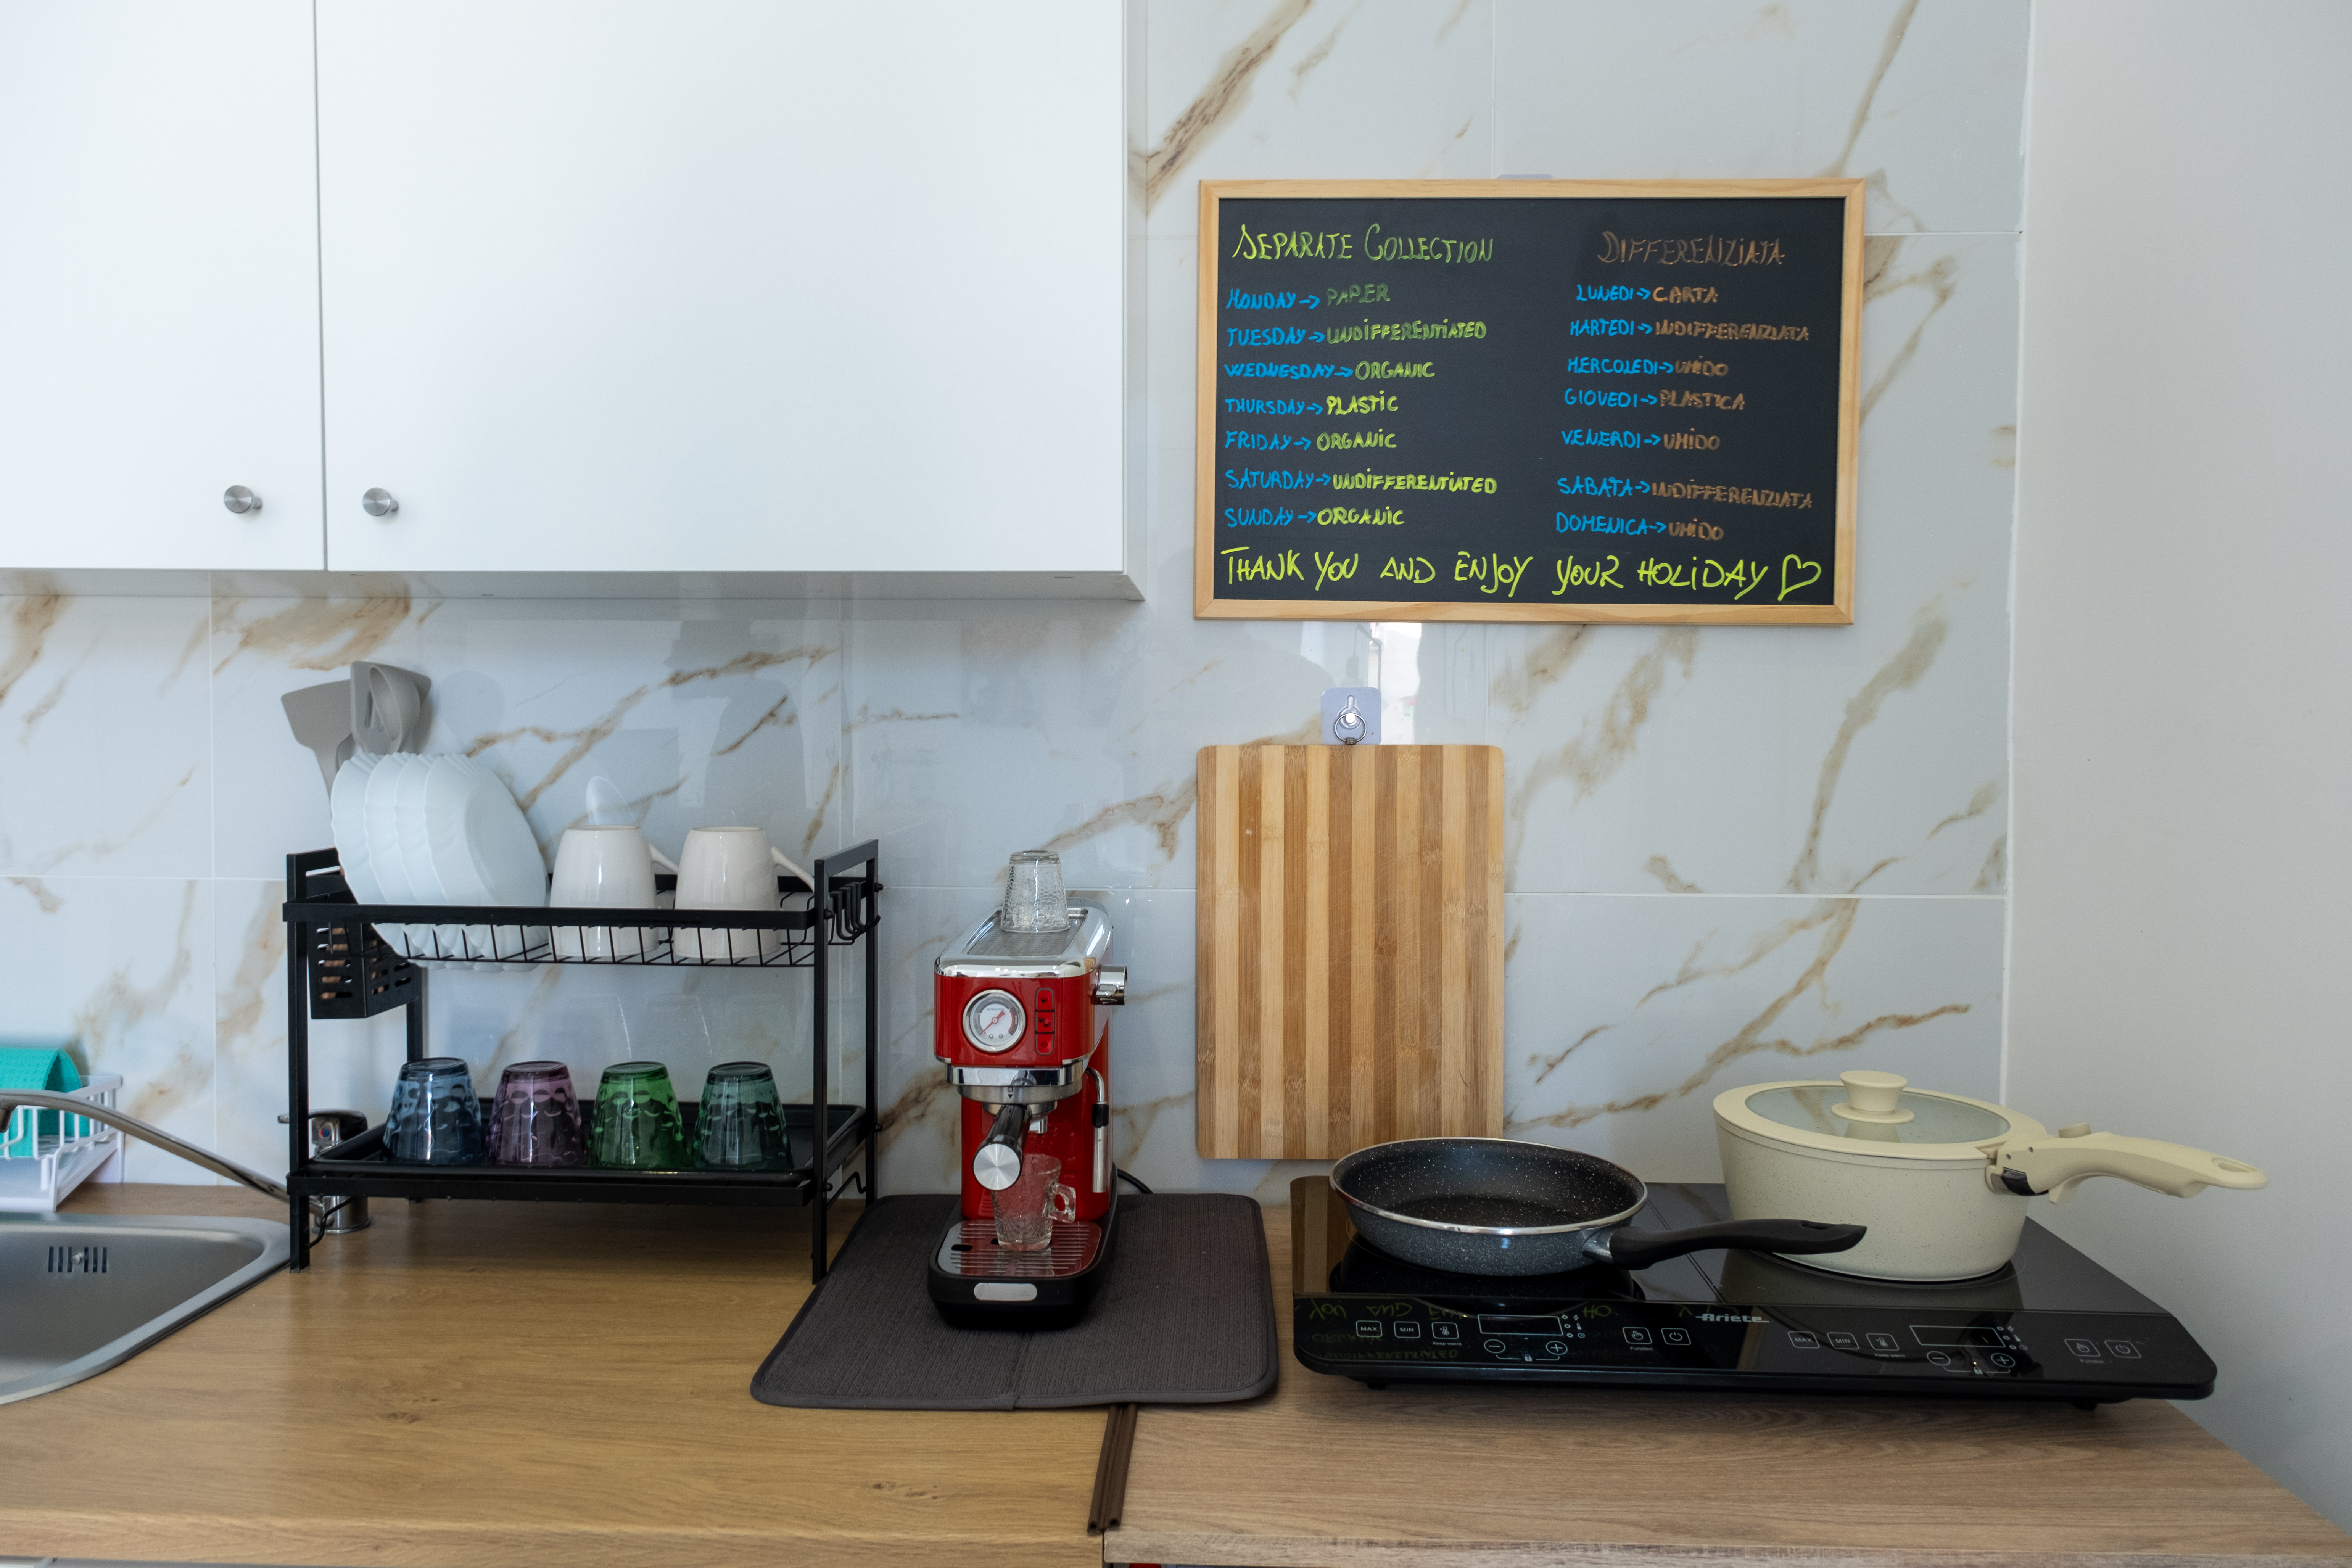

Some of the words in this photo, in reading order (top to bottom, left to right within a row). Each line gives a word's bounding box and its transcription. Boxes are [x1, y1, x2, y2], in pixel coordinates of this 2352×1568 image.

[1232, 224, 1352, 259] SEPARATE
[1365, 223, 1493, 263] COLLECTION
[1326, 283, 1391, 306] PAPER
[1576, 284, 1634, 301] LUNEDI
[1652, 286, 1719, 304] CARTA
[1227, 327, 1306, 347] TUESDAY
[1570, 318, 1634, 336] MARTEDI
[1655, 319, 1809, 341] INDIFFERENZIATA
[1224, 362, 1335, 379] WEDNESDAY
[1355, 361, 1435, 380] ORGANIC
[1567, 357, 1658, 375] MERCOLEDI
[1225, 398, 1305, 415] THURSDAY
[1564, 388, 1637, 407] GIOVEDI
[1659, 389, 1745, 410] PLASTICA
[1225, 431, 1293, 451] FRIDAY
[1561, 429, 1640, 448] VENERDI
[1225, 468, 1314, 490] SATURDAY
[1224, 507, 1294, 528] SUNDAY
[1556, 512, 1647, 535] DOMENICA
[1220, 546, 1304, 585] THANK
[1314, 551, 1359, 591] YOU
[1380, 557, 1436, 584] AND
[1454, 551, 1533, 598] ENJOY
[1552, 555, 1624, 595] YOUR
[1702, 1313, 1762, 1323] Ariete
